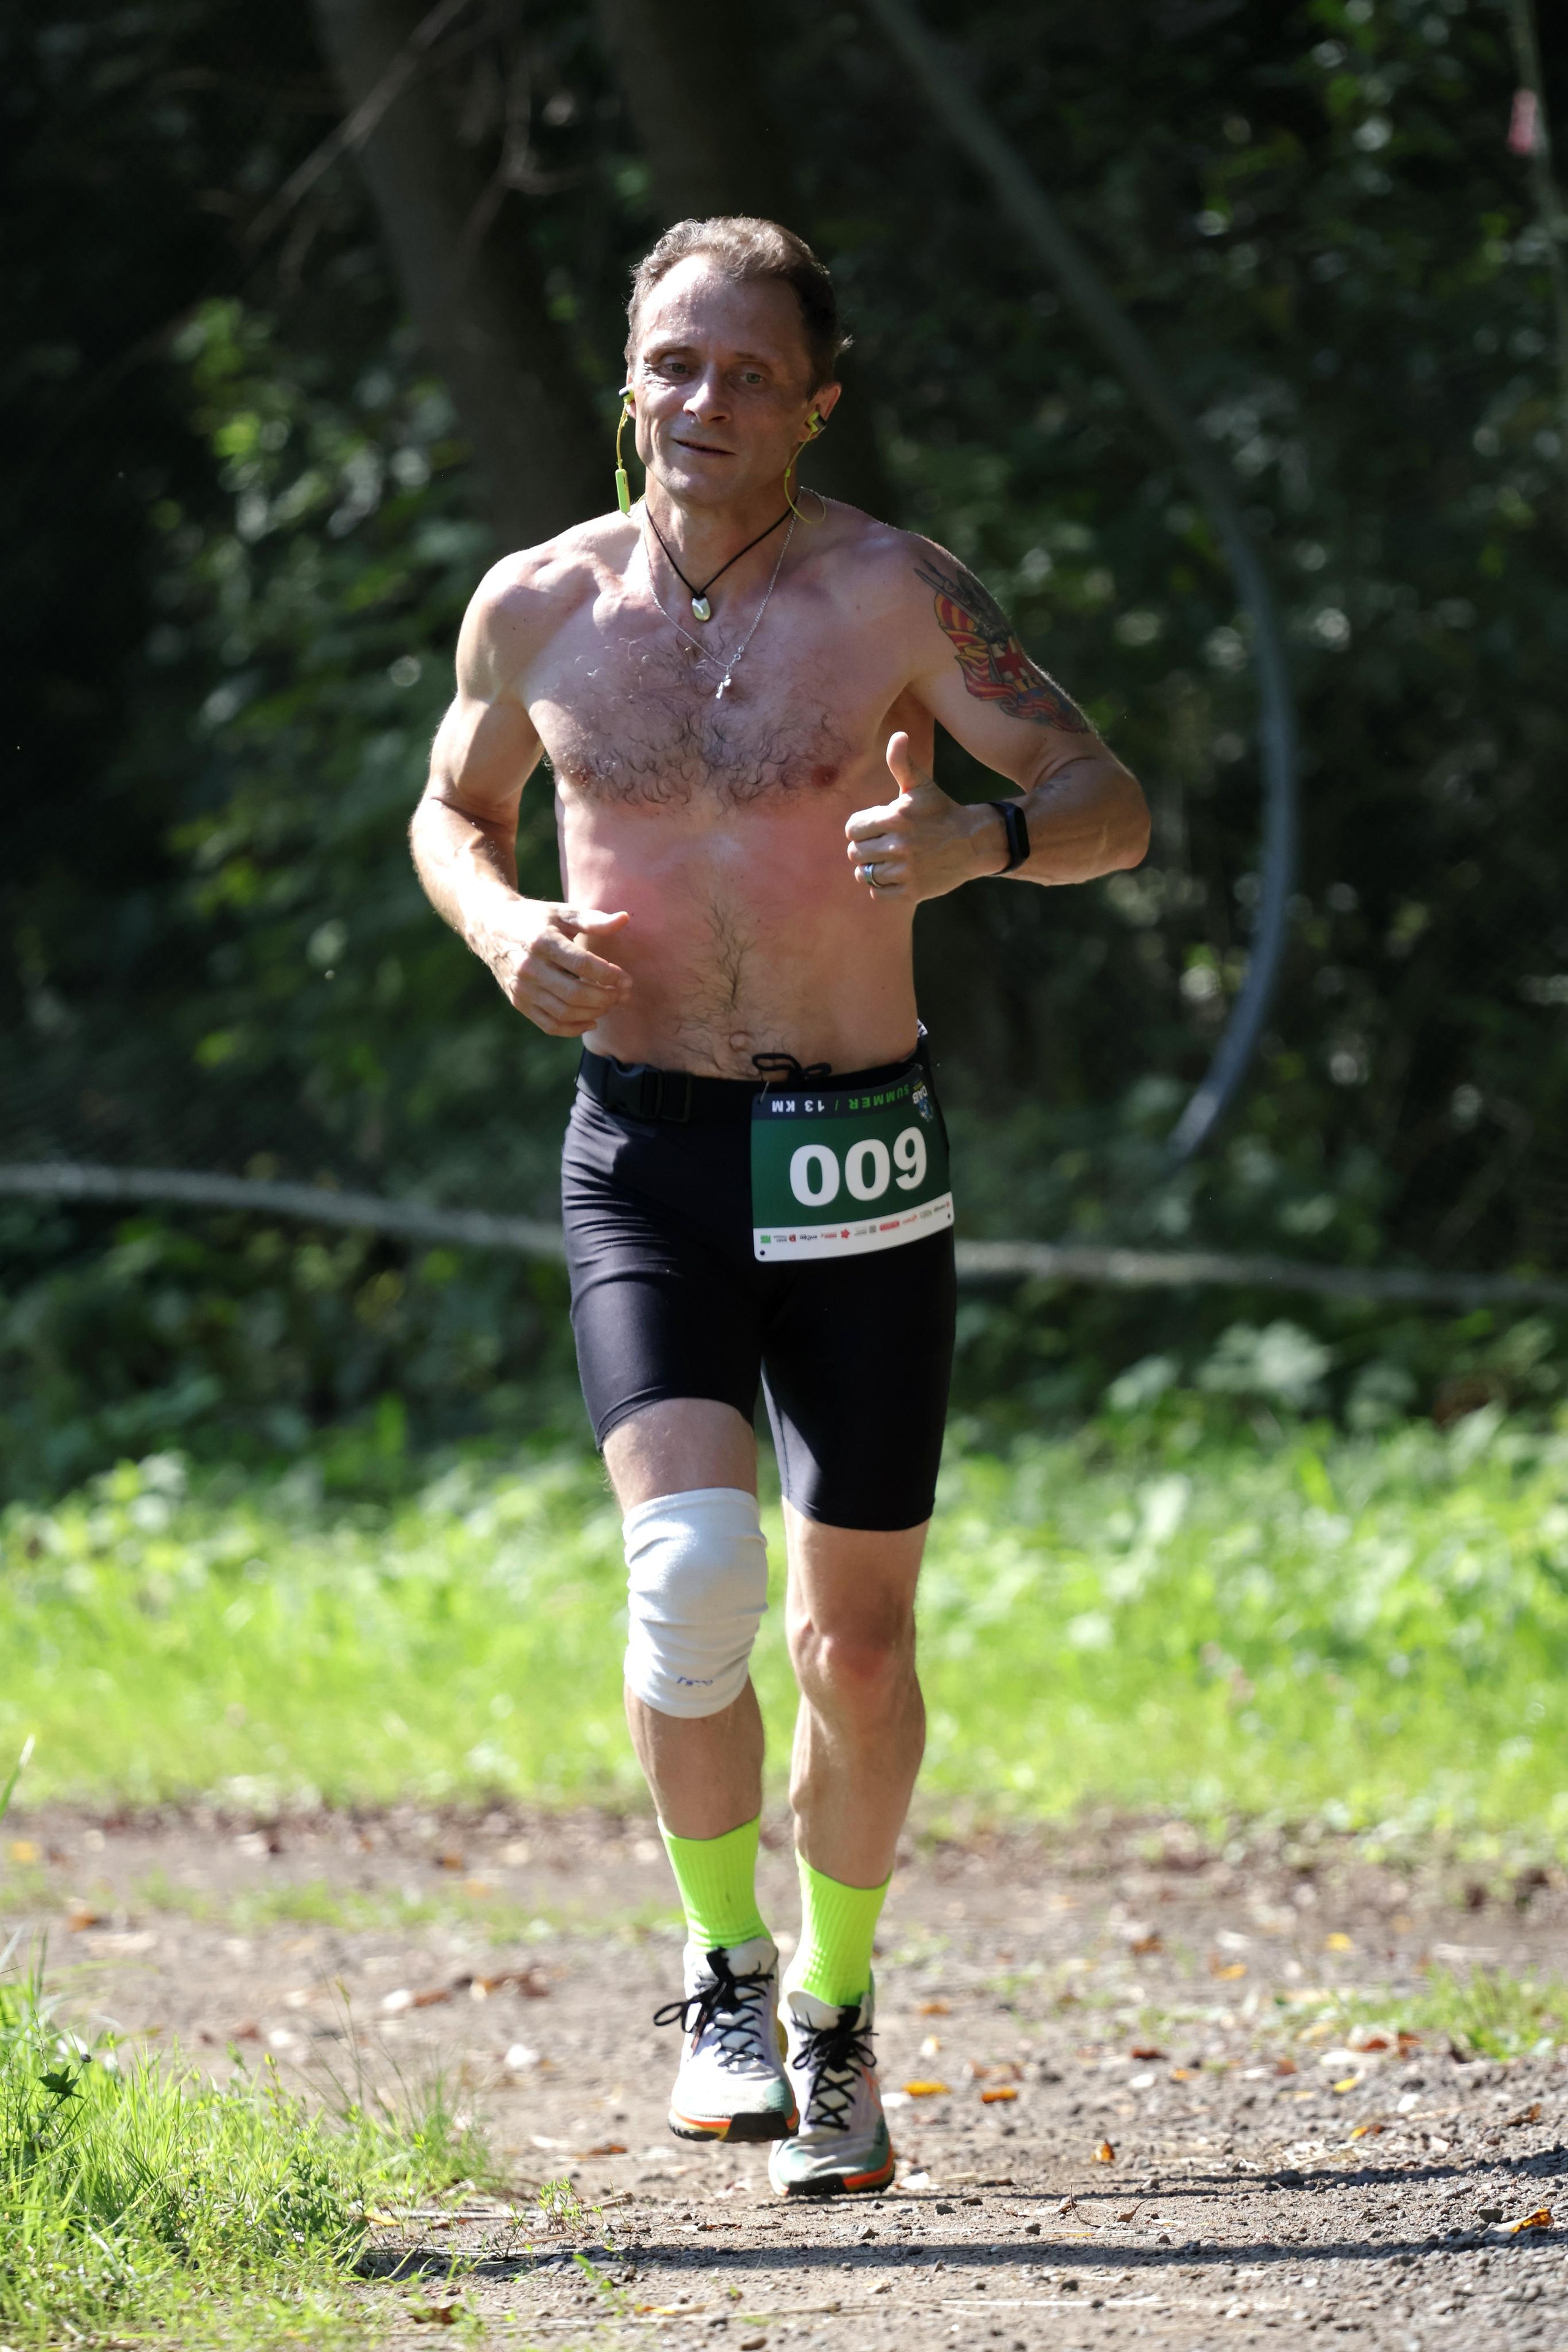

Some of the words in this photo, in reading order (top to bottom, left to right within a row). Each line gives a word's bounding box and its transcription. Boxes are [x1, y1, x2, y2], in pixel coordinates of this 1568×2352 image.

[848, 1083, 910, 1110] SUMMER
[771, 1099, 796, 1112] KM
[804, 1099, 825, 1112] 13
